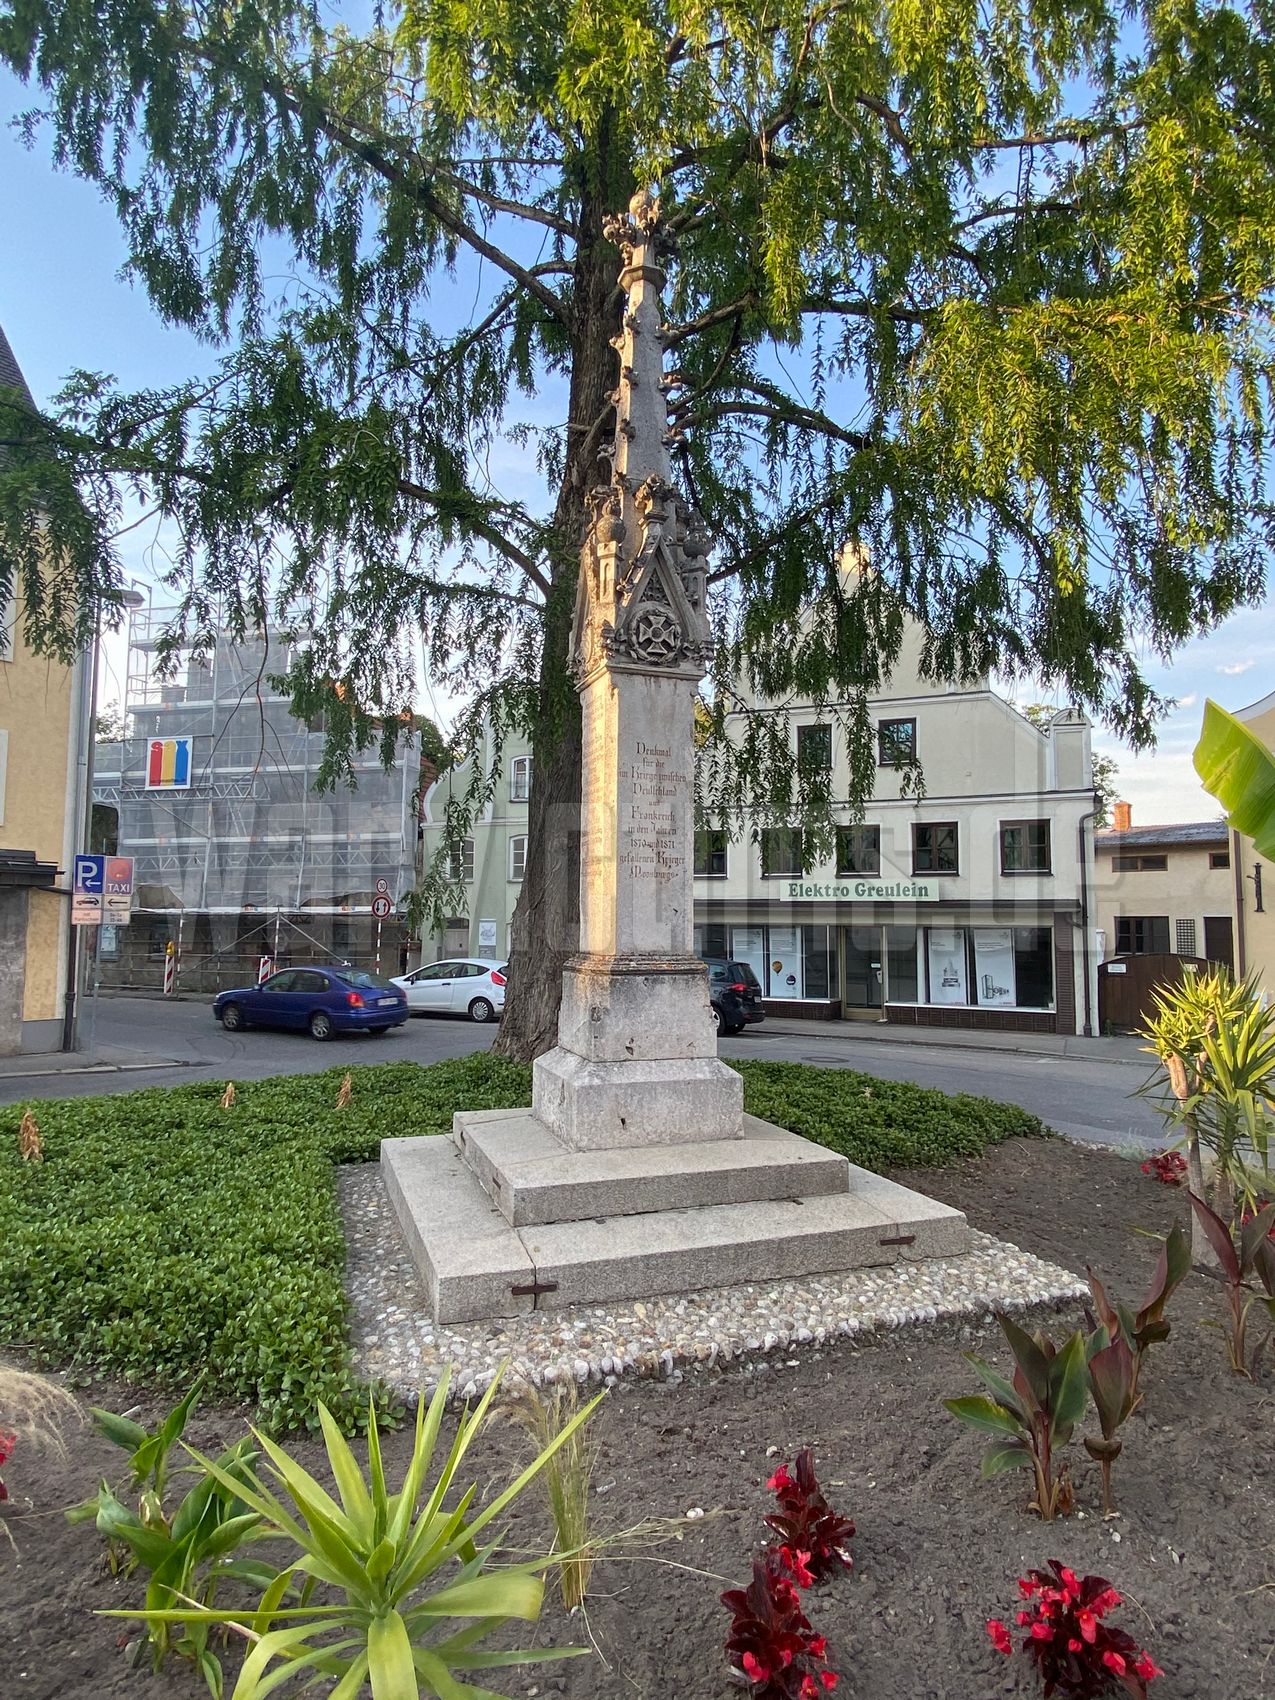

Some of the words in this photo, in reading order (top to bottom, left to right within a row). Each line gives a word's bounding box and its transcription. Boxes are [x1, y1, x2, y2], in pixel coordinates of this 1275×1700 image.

[636, 741, 673, 757] Denkmal
[655, 758, 665, 769] die
[636, 823, 649, 834] den
[660, 839, 675, 849] 1871
[656, 850, 686, 867] Krieger
[77, 861, 98, 888] P
[107, 883, 130, 893] TAXI
[788, 882, 850, 898] Elektro
[854, 882, 929, 898] Greulein
